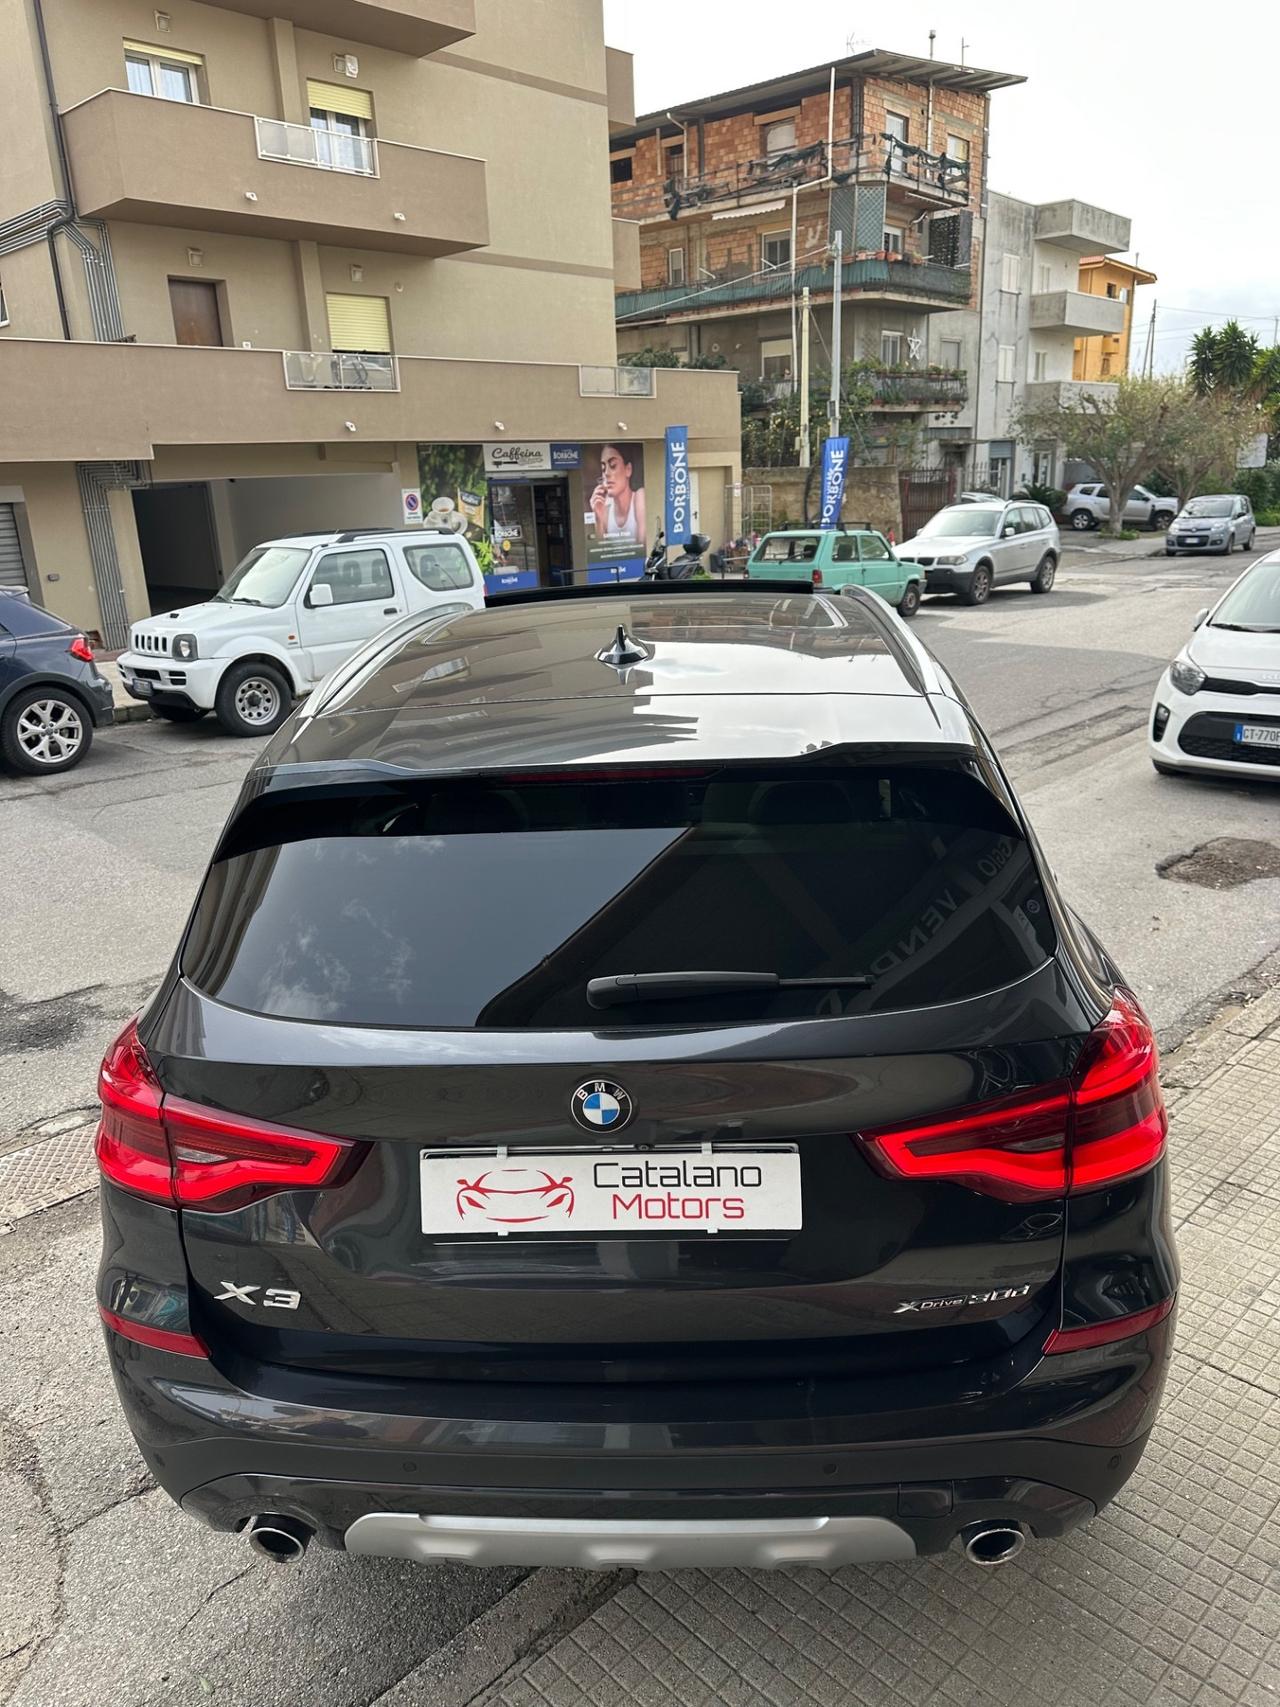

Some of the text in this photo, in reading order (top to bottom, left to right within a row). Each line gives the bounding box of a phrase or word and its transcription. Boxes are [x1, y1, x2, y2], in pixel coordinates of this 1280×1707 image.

[491, 447, 543, 460] Caffeina
[670, 442, 687, 533] BORBONE
[576, 1082, 626, 1101] BMW
[593, 1160, 762, 1188] Catalano
[612, 1191, 745, 1219] Motors
[213, 1280, 301, 1310] X3
